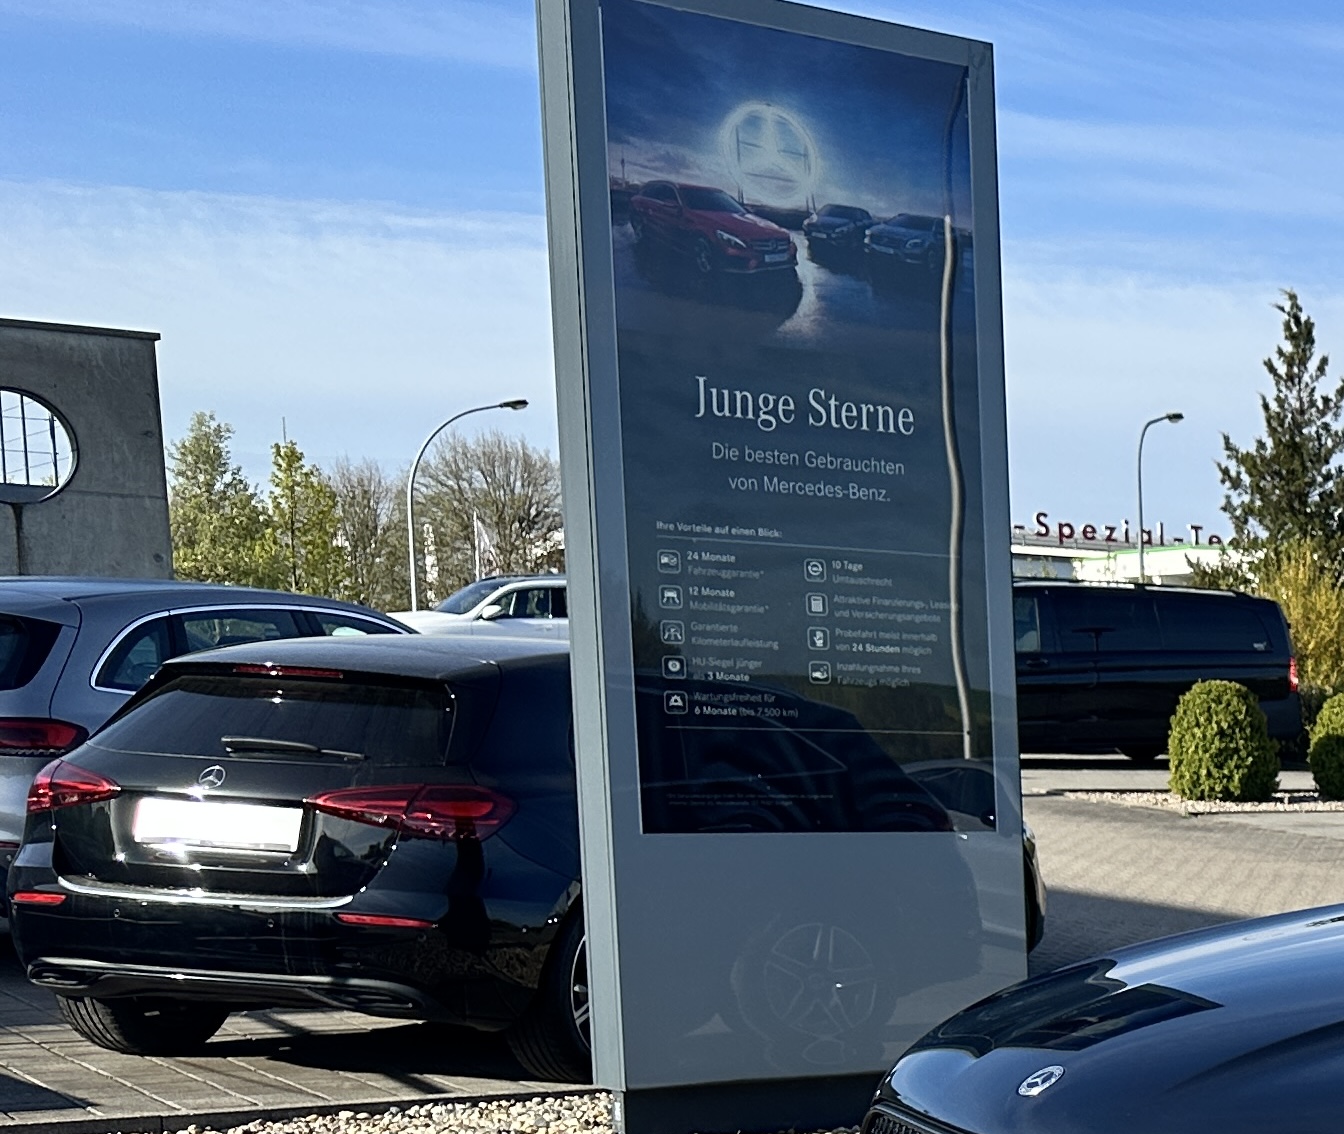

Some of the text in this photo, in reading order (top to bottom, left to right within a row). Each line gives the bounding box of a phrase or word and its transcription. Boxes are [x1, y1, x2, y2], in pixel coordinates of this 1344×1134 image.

[695, 376, 915, 436] Junge Sterne
[711, 442, 905, 476] Die besten Gebrauchten
[728, 475, 891, 502] von Mercedes-Benz.
[656, 520, 675, 531] Ihre
[676, 522, 713, 534] Vorteile
[714, 525, 729, 536] auf
[730, 527, 757, 537] einen
[686, 551, 736, 563] 24 Monate
[831, 560, 863, 572] 10 Tage
[688, 586, 735, 598] 12 Monate
[852, 642, 863, 652] 24
[865, 642, 900, 654] Stunden
[707, 671, 714, 681] 3
[715, 671, 750, 682] Monate
[694, 706, 701, 715] 6
[702, 706, 738, 717] Monate
